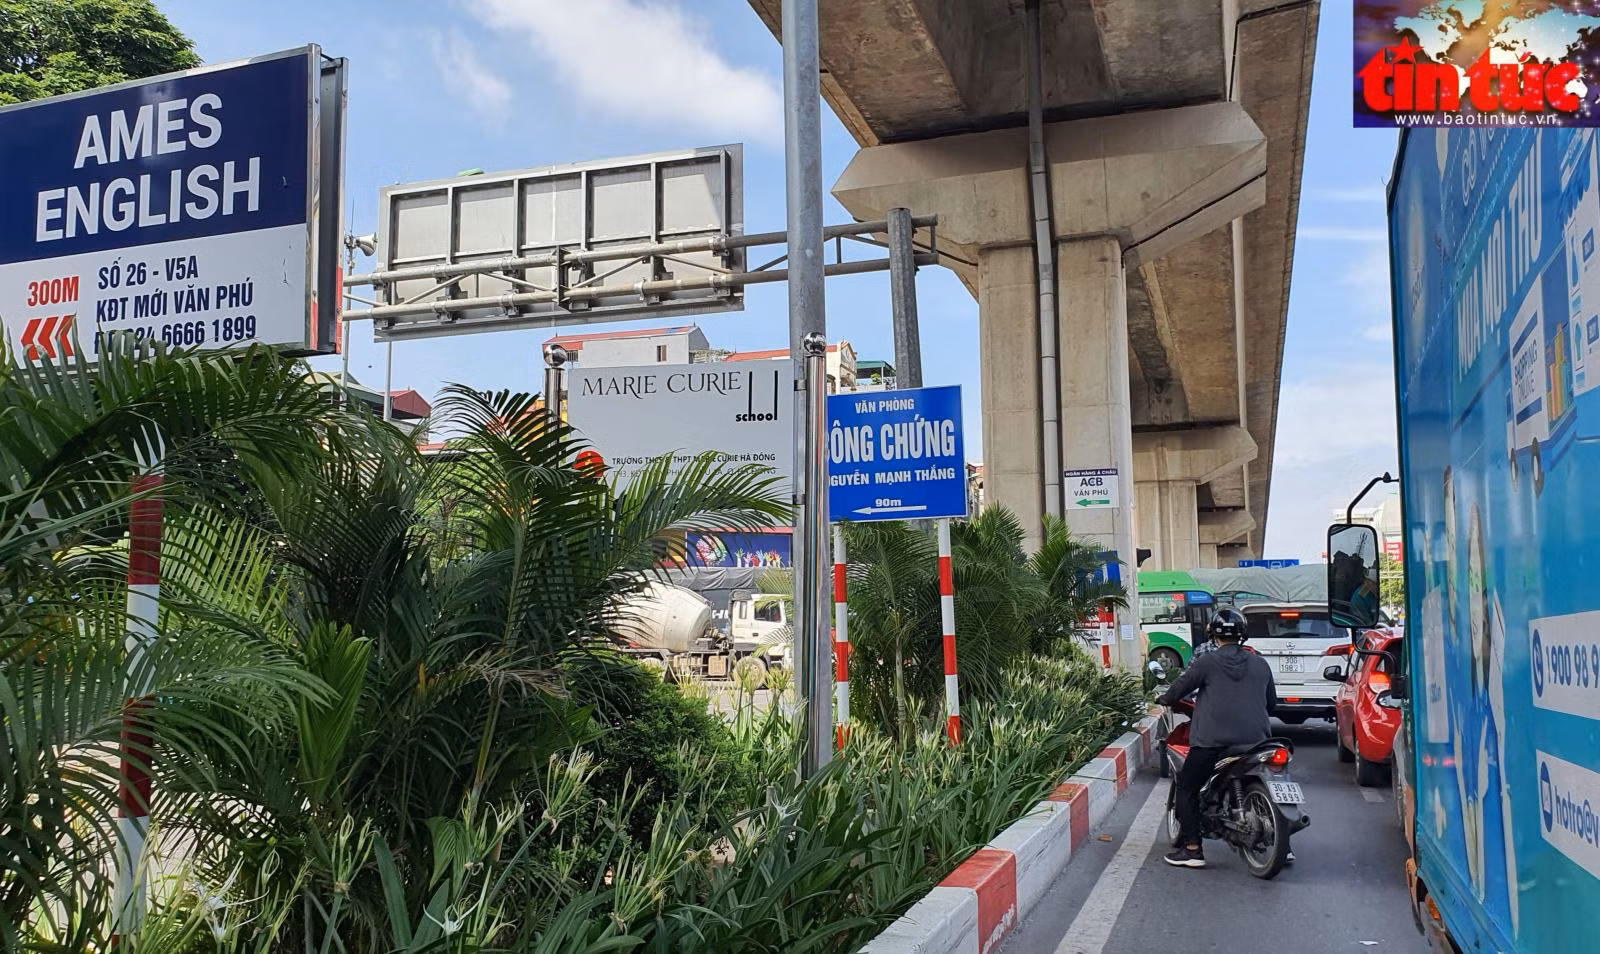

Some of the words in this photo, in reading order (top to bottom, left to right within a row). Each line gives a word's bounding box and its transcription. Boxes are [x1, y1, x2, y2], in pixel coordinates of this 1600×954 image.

[73, 93, 223, 170] AMES
[36, 157, 261, 243] ENGLISH
[98, 257, 121, 290] SỐ
[126, 262, 147, 287] 26
[165, 255, 199, 282] V5A
[28, 276, 79, 307] 300M
[96, 297, 128, 323] KĐT
[134, 287, 168, 318] MỚI
[174, 284, 210, 315] VĂN
[216, 277, 254, 311] PHÚ
[1458, 264, 1481, 384] MUA
[1481, 206, 1508, 348] MỌI
[162, 320, 206, 348] 6666
[212, 315, 257, 343] 1899
[582, 375, 657, 400] MARIE
[667, 371, 741, 396] CURIE
[735, 370, 778, 422] school
[855, 401, 877, 414] VĂN
[881, 413, 956, 461] CHỨNG
[829, 468, 870, 487] GUYỄN
[875, 470, 912, 485] MẠNH
[915, 465, 955, 481] THẮNG
[1080, 477, 1104, 487] ACB
[875, 498, 902, 508] 90m
[1545, 644, 1572, 686] 1900
[1574, 644, 1589, 688] 98
